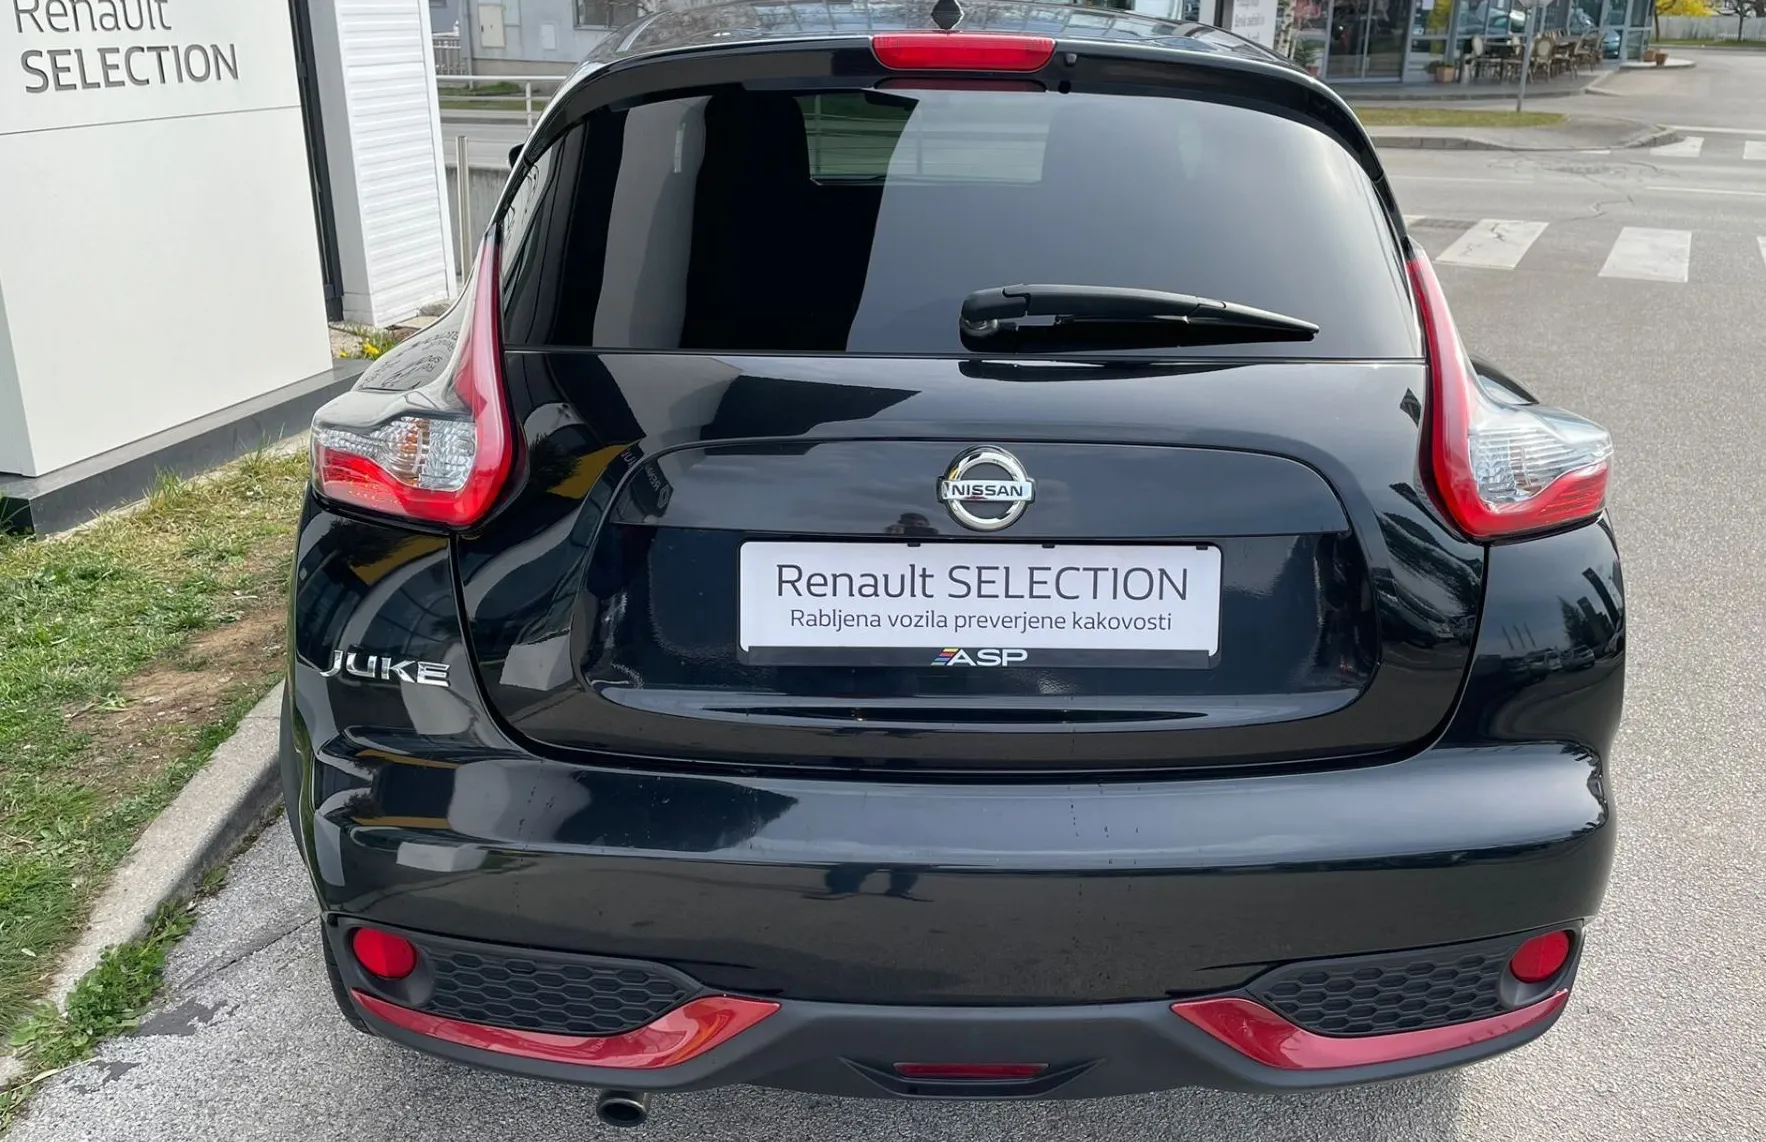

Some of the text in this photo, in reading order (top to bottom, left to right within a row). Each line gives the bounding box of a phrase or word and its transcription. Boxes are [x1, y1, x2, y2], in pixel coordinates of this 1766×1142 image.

[13, 0, 171, 33] Renault
[21, 44, 239, 93] SELECTION
[952, 484, 1023, 497] NISSAN
[776, 563, 1188, 601] Renault SELECTION
[790, 608, 1172, 634] Rabljena vozila preverjene kakovosti
[319, 649, 450, 688] JUKE
[946, 648, 1028, 667] ASP
